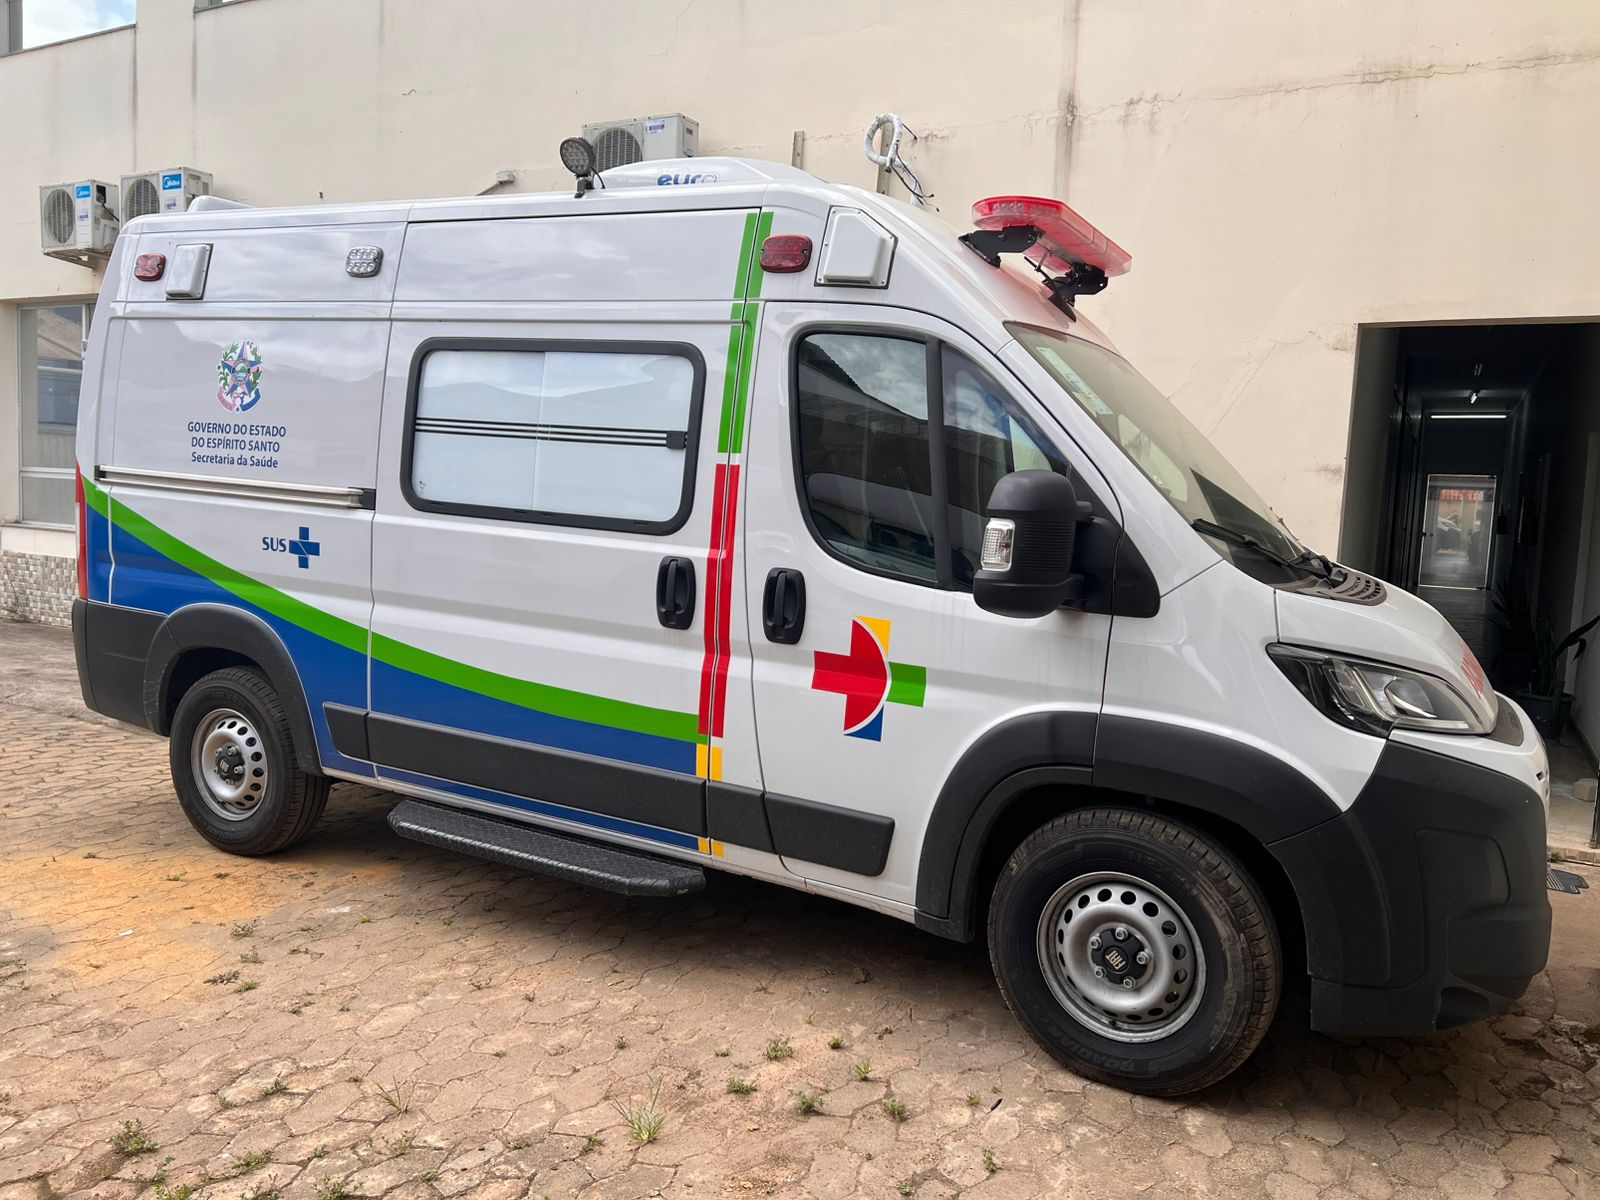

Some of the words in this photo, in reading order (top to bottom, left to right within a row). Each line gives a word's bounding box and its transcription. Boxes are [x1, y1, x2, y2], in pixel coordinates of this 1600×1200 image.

[187, 421, 231, 434] GOVERNO
[233, 424, 247, 435] DO
[249, 424, 286, 437] ESTADO
[191, 436, 204, 448] DO
[206, 436, 246, 451] ESPÍRITO
[248, 440, 280, 453] SANTO
[191, 451, 235, 465] Secretaria
[236, 455, 247, 466] da
[249, 455, 278, 468] Saúde
[261, 536, 287, 552] SUS
[1105, 950, 1126, 970] FIAT
